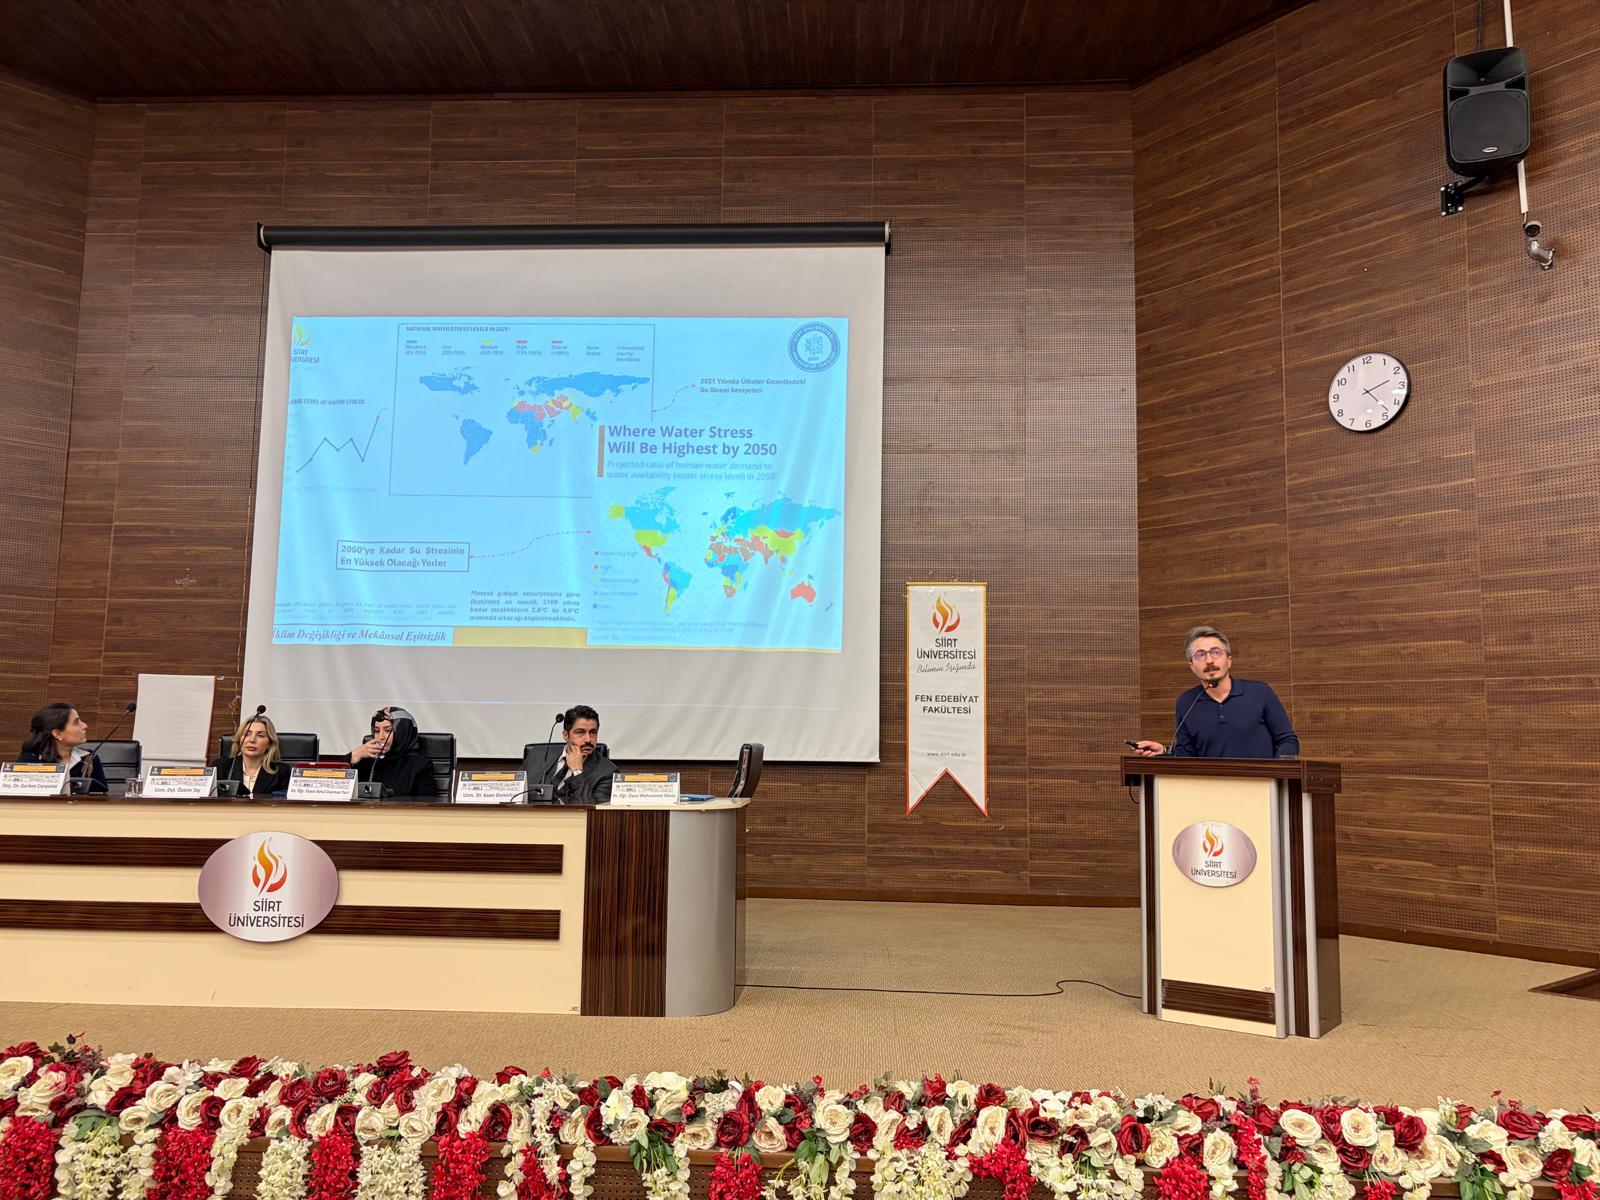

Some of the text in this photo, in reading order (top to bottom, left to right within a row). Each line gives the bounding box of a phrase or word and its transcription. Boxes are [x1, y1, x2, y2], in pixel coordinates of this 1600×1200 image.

[1362, 356, 1372, 364] 12
[1382, 358, 1386, 366] 1
[1347, 365, 1355, 373] 11
[1393, 366, 1401, 375] 2
[741, 377, 765, 385] Ülkeler
[1337, 378, 1347, 386] 10
[1398, 381, 1405, 389] 3
[731, 387, 763, 395] Seviyeleri
[1333, 394, 1339, 402] 9
[1393, 398, 1400, 406] 4
[1337, 409, 1344, 417] 8
[1381, 412, 1389, 420] 5
[1349, 418, 1355, 426] 7
[1365, 420, 1372, 428] 6
[608, 425, 753, 438] Where Water Stress
[607, 441, 777, 458] Will Be Highest by 2050
[607, 460, 644, 471] Projected
[645, 461, 663, 470] ratio
[665, 461, 674, 470] of
[675, 461, 704, 470] human
[729, 461, 762, 470] demand
[607, 471, 628, 479] water
[673, 471, 697, 481] (water
[724, 472, 745, 481] level)
[746, 472, 755, 480] in
[340, 545, 465, 556] 2050'ye Kadar Su Stresinin
[340, 557, 448, 569] En Yüksek Olacağı Yerler
[296, 629, 346, 642] Değişikliği
[347, 631, 357, 639] ve
[359, 629, 405, 641] Mekânsal
[405, 630, 447, 643] Eşitsizlik
[935, 637, 958, 648] SİİRT
[916, 648, 977, 660] ÜNİVERSİTESİ
[914, 694, 979, 703] FEN EDEBİYAT
[922, 705, 972, 715] FAKÜLTESİ
[1204, 860, 1223, 868] SİİRT
[1190, 867, 1237, 879] ÜNİVERSİTESİ
[253, 898, 283, 912] SİİRT
[228, 912, 305, 928] ÜNİVERSİTESİ
